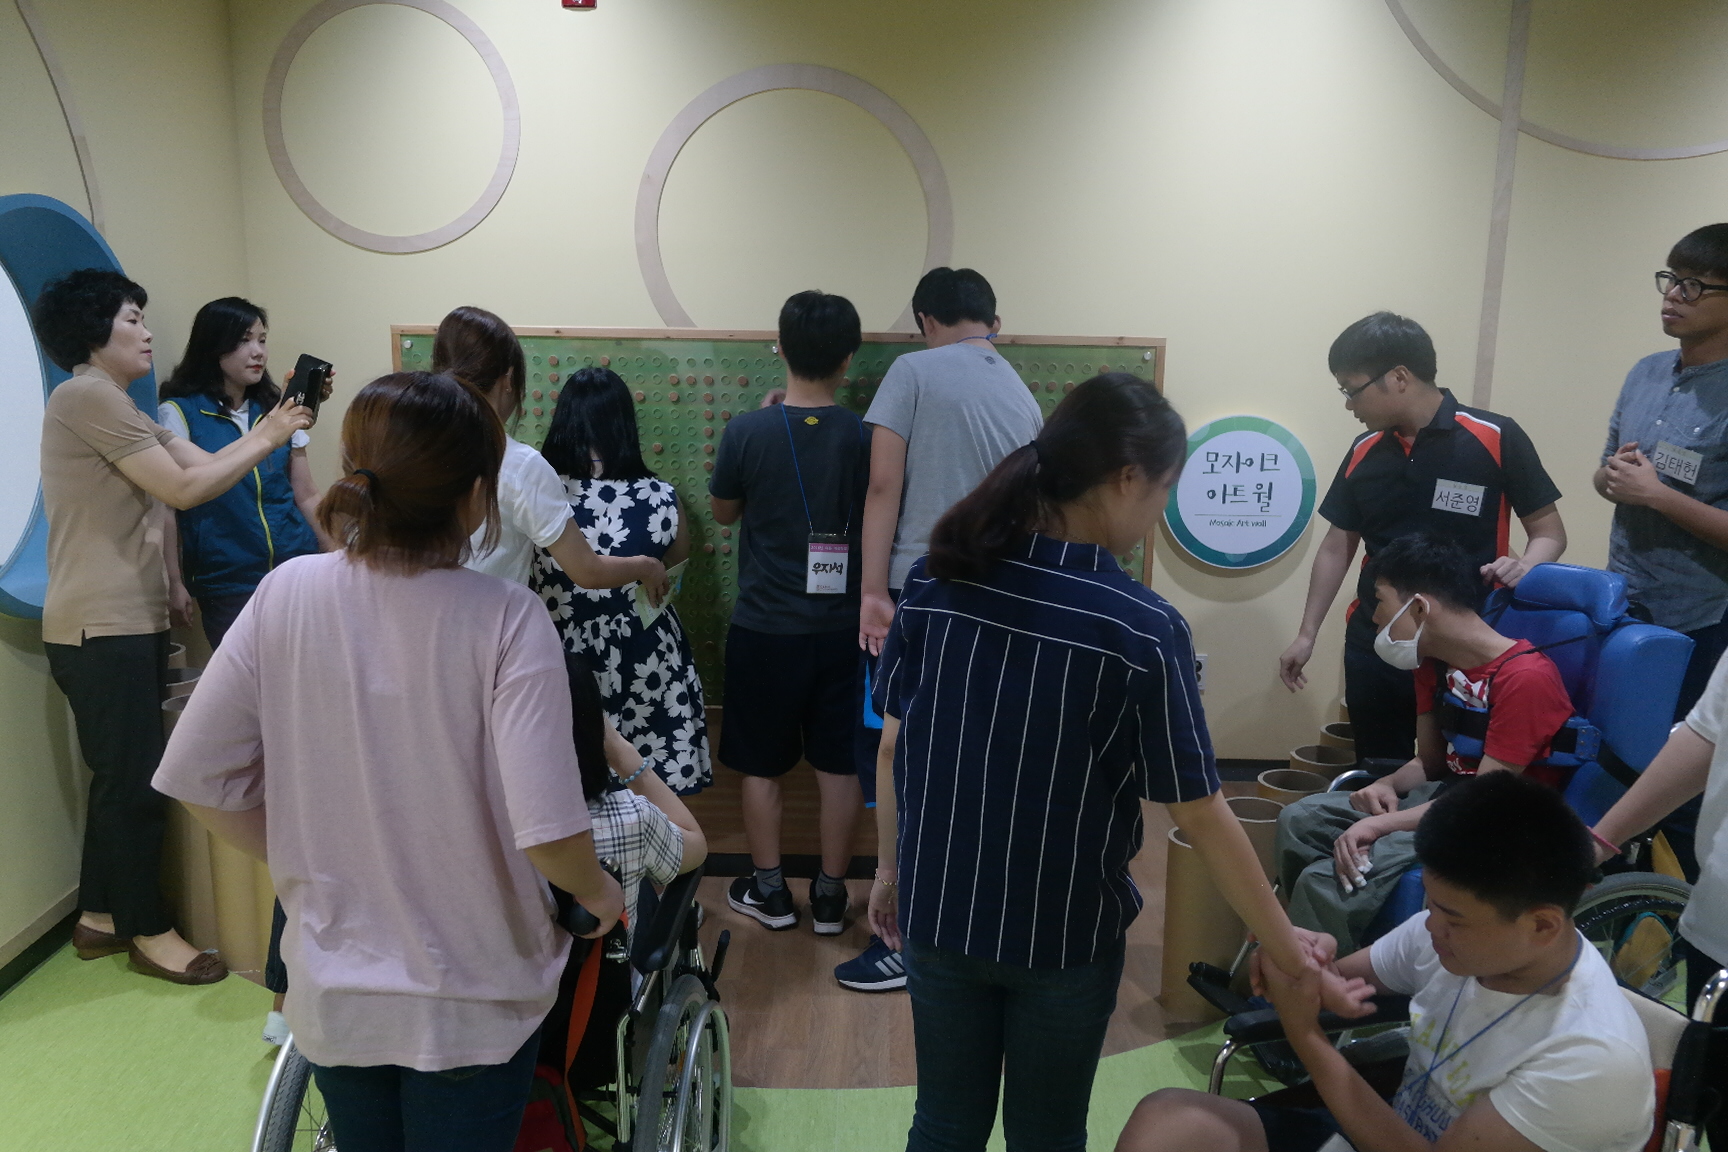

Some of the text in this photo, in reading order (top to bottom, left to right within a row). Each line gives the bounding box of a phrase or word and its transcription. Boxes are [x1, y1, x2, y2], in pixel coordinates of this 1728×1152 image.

[1202, 451, 1281, 475] 모자이크
[1655, 452, 1698, 481] 김태헌
[1206, 481, 1274, 513] 아트월
[1435, 490, 1480, 513] 서준영
[1209, 518, 1234, 528] Mosaic
[1236, 519, 1249, 527] Art
